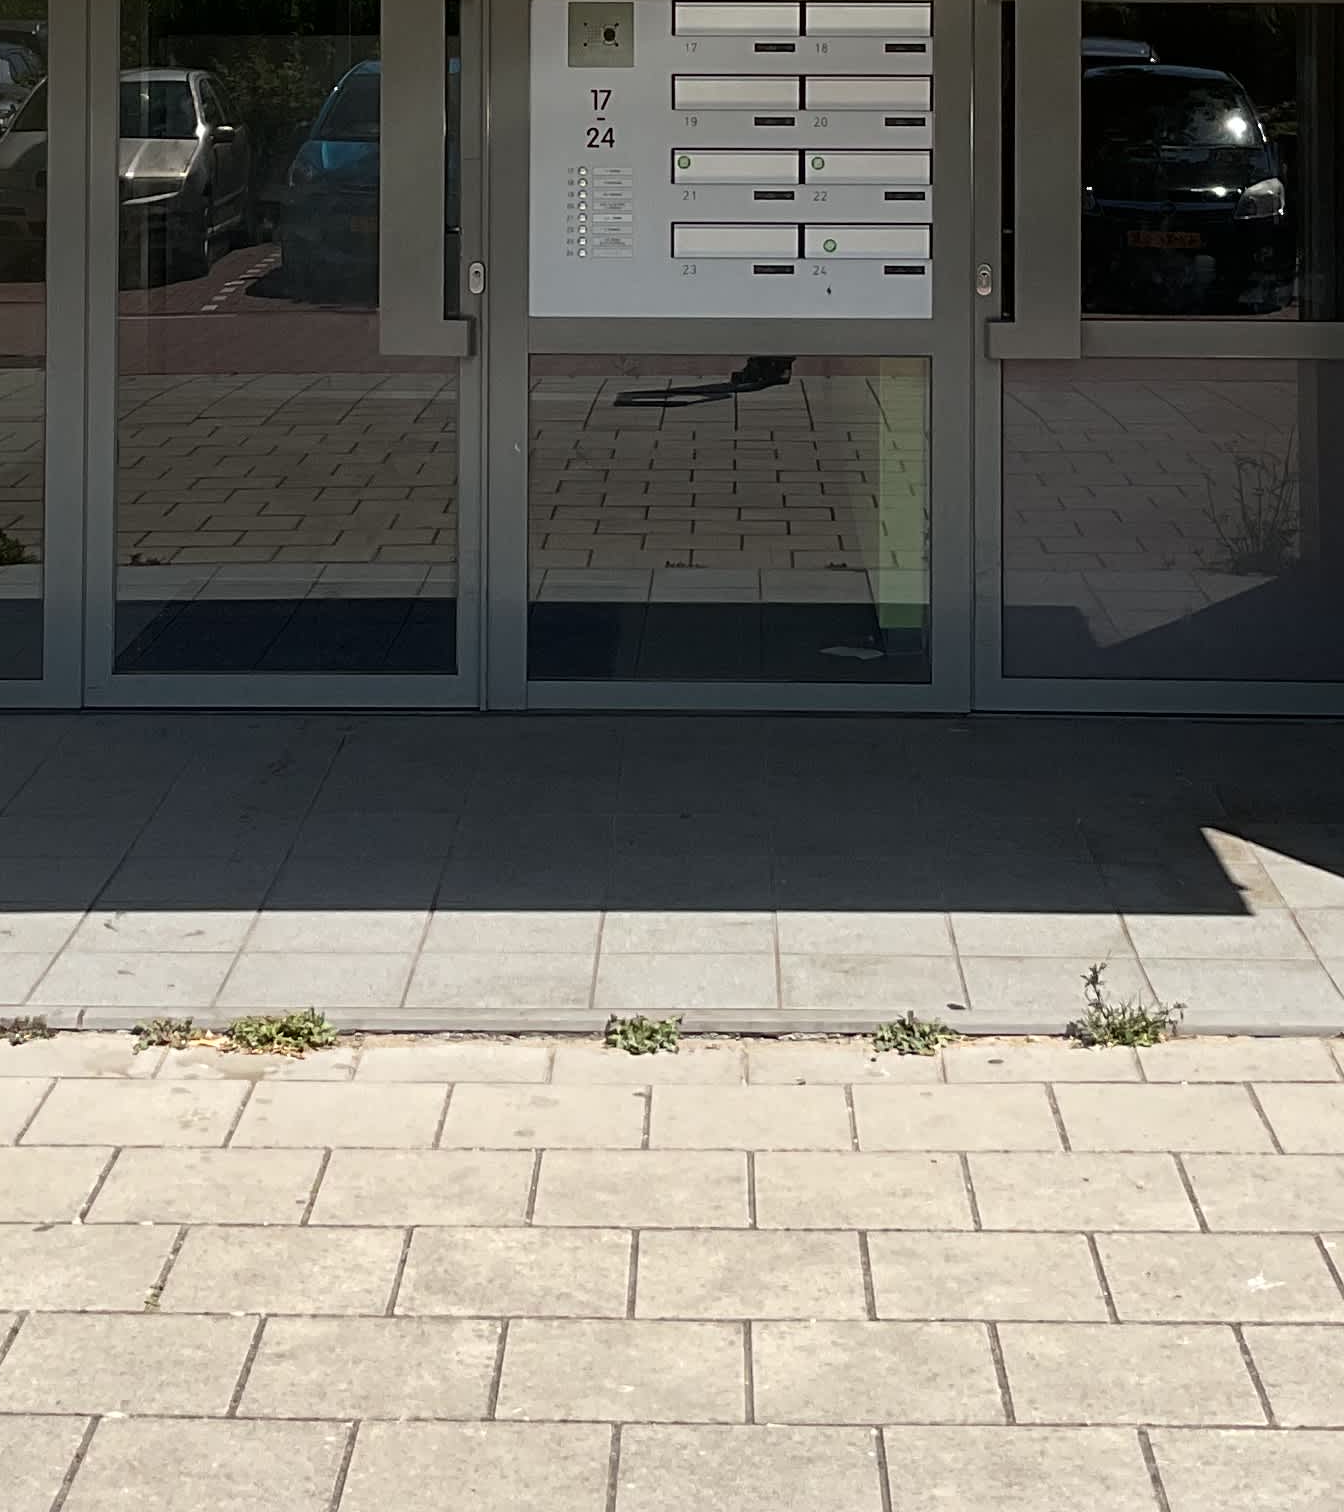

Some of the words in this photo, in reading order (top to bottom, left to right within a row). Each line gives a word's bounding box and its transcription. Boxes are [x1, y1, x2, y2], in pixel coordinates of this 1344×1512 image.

[685, 42, 698, 53] 17
[815, 42, 828, 54] 18
[590, 89, 612, 111] 17
[684, 116, 698, 128] 19
[813, 116, 829, 128] 20
[586, 127, 616, 149] 24
[682, 190, 697, 201] 21
[812, 190, 828, 202] 22
[682, 264, 697, 276] 23
[812, 264, 828, 276] 24
